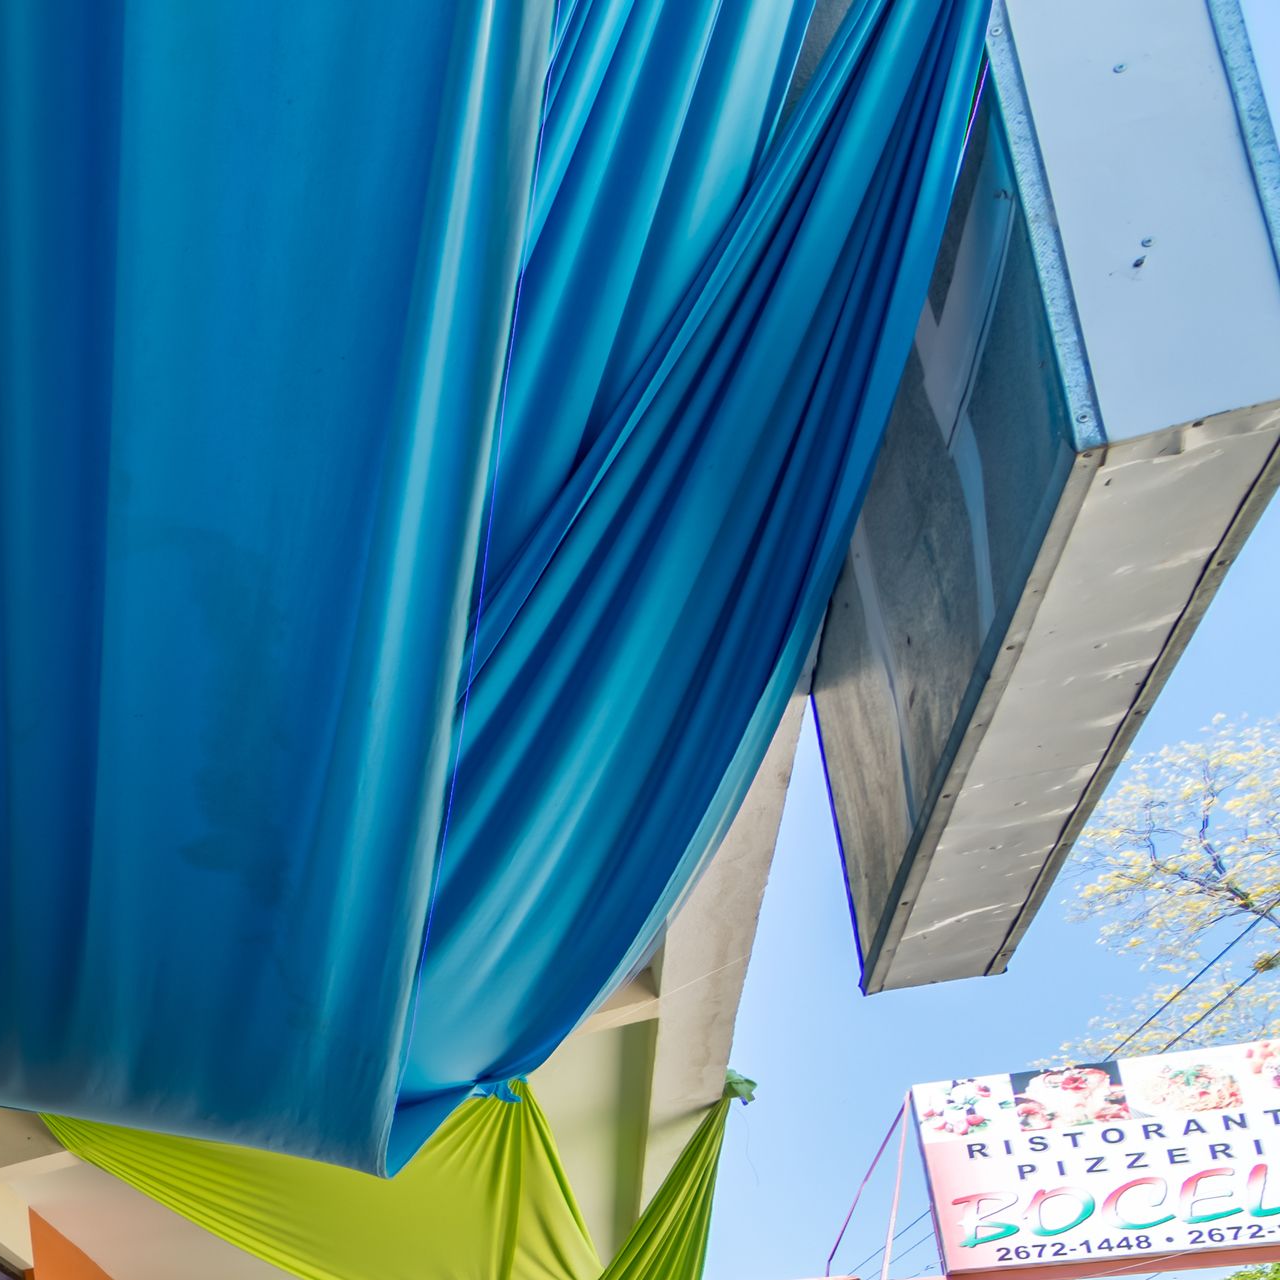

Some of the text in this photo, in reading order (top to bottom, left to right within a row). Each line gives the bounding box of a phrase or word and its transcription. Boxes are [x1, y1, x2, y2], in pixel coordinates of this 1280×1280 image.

[967, 1109, 1280, 1158] RISTORANT
[1018, 1139, 1263, 1180] PIZZERI
[952, 1163, 1280, 1248] BOCEL
[996, 1224, 1280, 1262] 2672-1448 2672-
